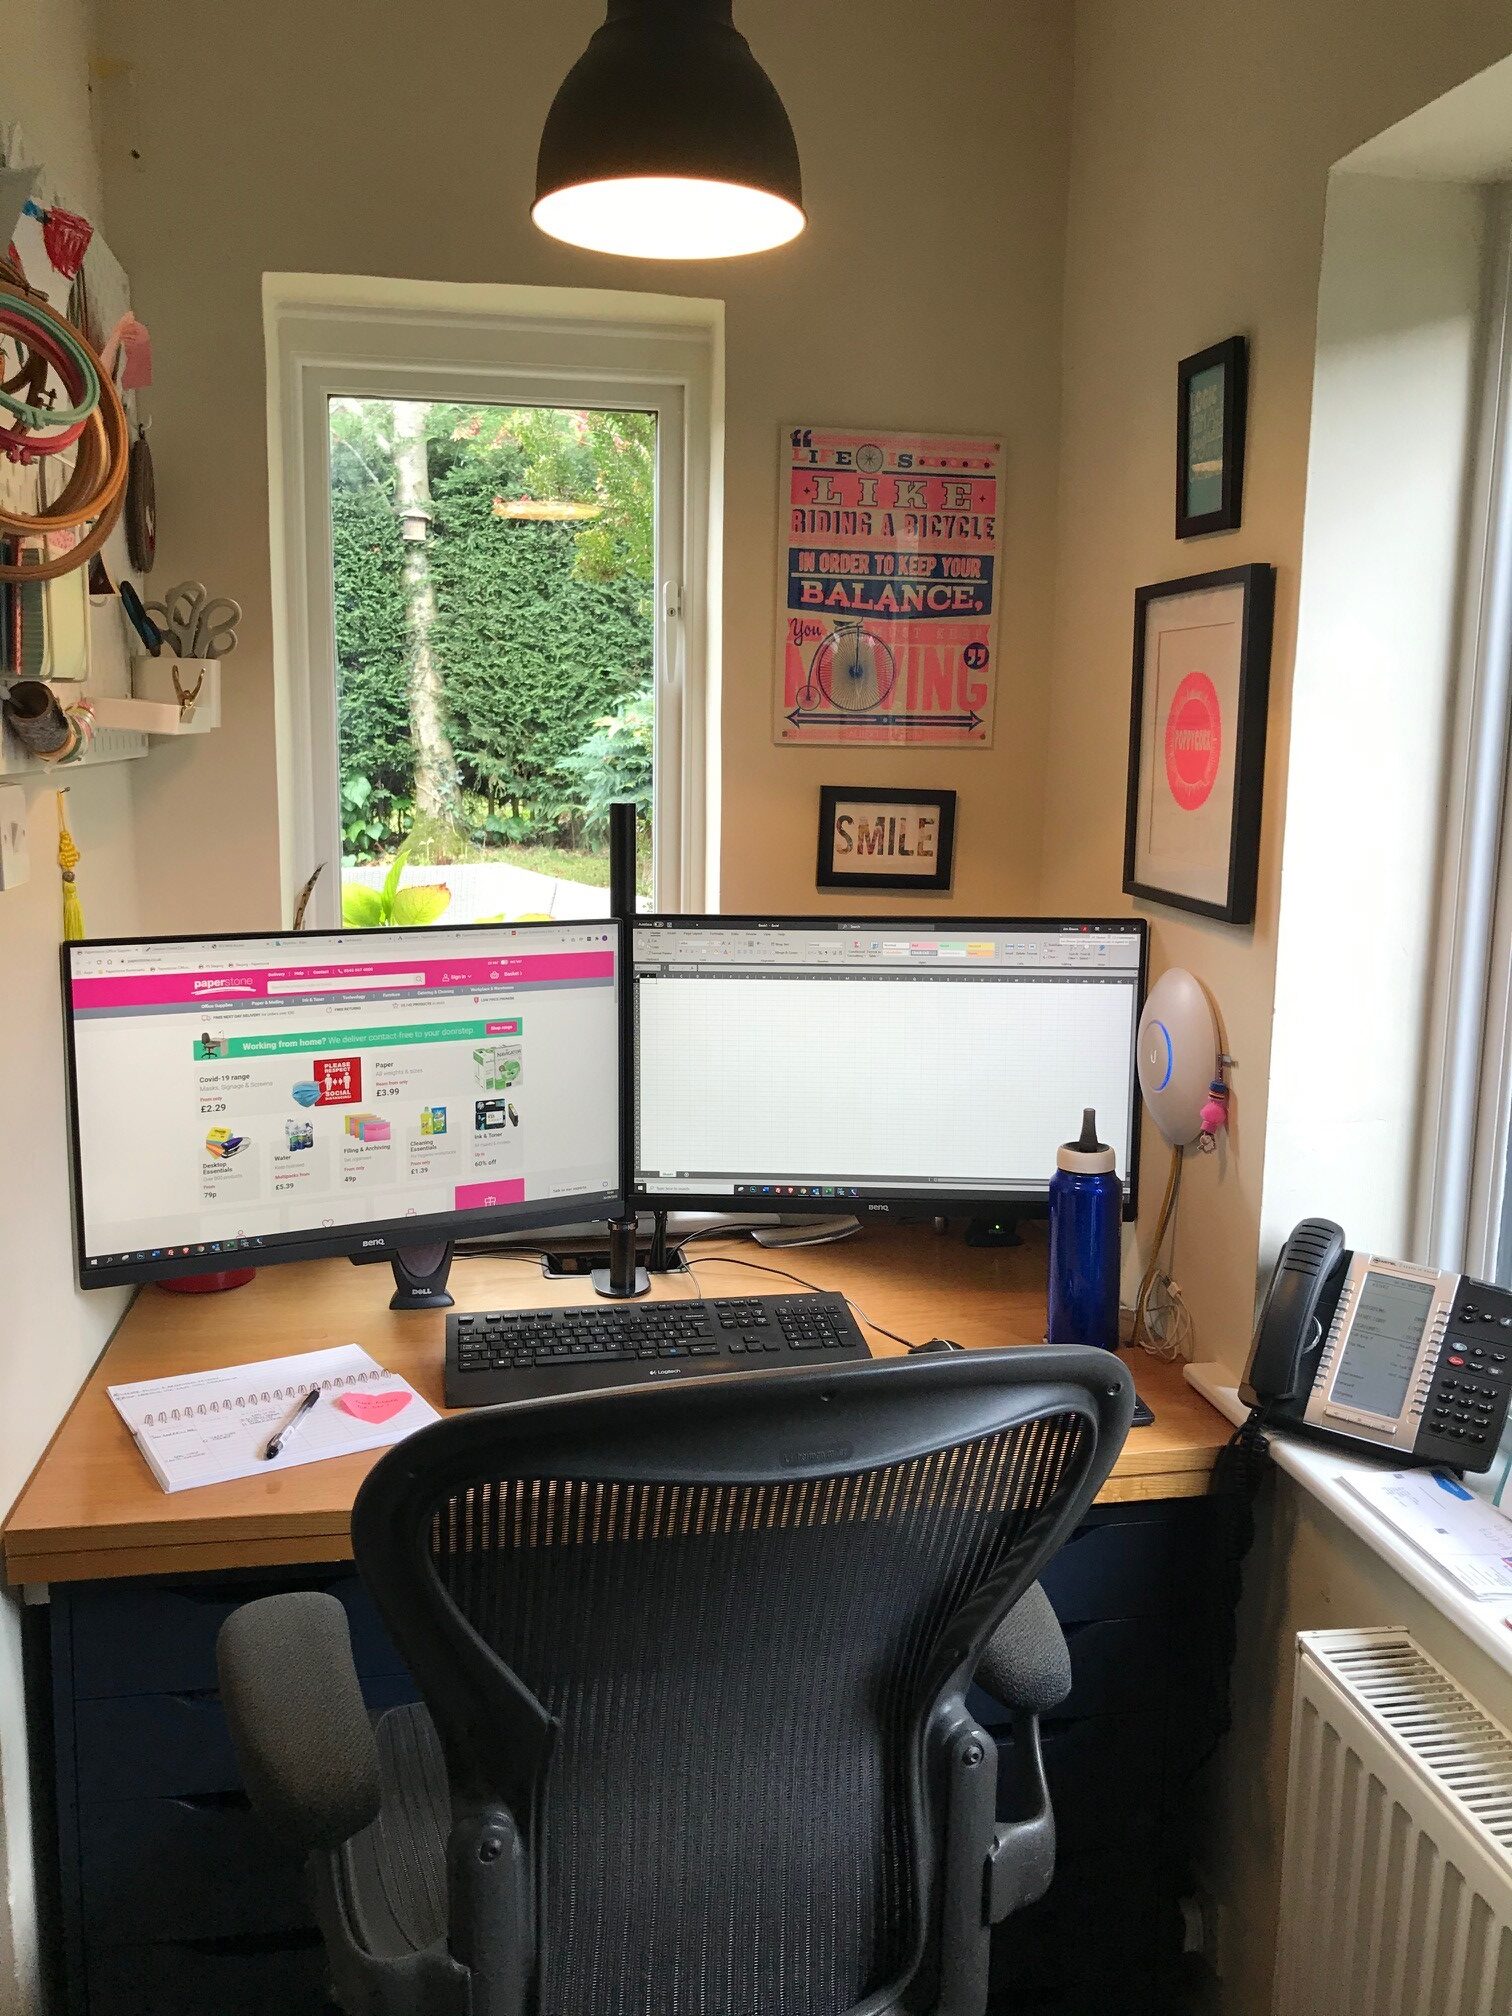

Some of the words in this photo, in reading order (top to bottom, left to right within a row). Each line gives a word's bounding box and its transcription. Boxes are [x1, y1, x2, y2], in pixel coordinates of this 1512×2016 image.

[792, 450, 852, 465] LIFE
[888, 453, 912, 468] IS
[812, 476, 972, 511] LIKE
[791, 509, 872, 535] RIDING
[880, 513, 895, 537] A
[904, 513, 995, 540] BICYCLE
[798, 551, 814, 572] IN
[819, 552, 870, 574] ORDER
[874, 554, 894, 575] TO
[898, 554, 937, 577] KEEP
[941, 556, 981, 578] YOUR
[800, 581, 983, 613] BALANCE,
[790, 618, 822, 646] You
[836, 814, 934, 857] SMILE
[194, 977, 253, 989] paperstone
[243, 1041, 277, 1051] Working
[278, 1040, 298, 1048] from
[299, 1037, 327, 1047] home?
[328, 1036, 341, 1045] We
[342, 1034, 367, 1044] deliver
[414, 1029, 423, 1038] to
[424, 1029, 440, 1040] your
[324, 1066, 351, 1074] RESPECT
[375, 1061, 394, 1070] Paper
[199, 1074, 230, 1084] Covid-19
[231, 1073, 250, 1082] range
[220, 1081, 245, 1091] Signage
[376, 1087, 400, 1097] £3.99
[201, 1103, 227, 1114] £2.29
[365, 1143, 391, 1153] Archiving
[410, 1139, 434, 1148] Cleaning
[410, 1144, 437, 1153] Essentials
[488, 1158, 497, 1166] off
[202, 1167, 233, 1175] Essentials
[344, 1175, 357, 1184] 49p
[275, 1183, 295, 1191] £5.39
[868, 1204, 889, 1212] BenQ
[362, 1238, 385, 1247] BenQ
[657, 1368, 681, 1376] Logitech
